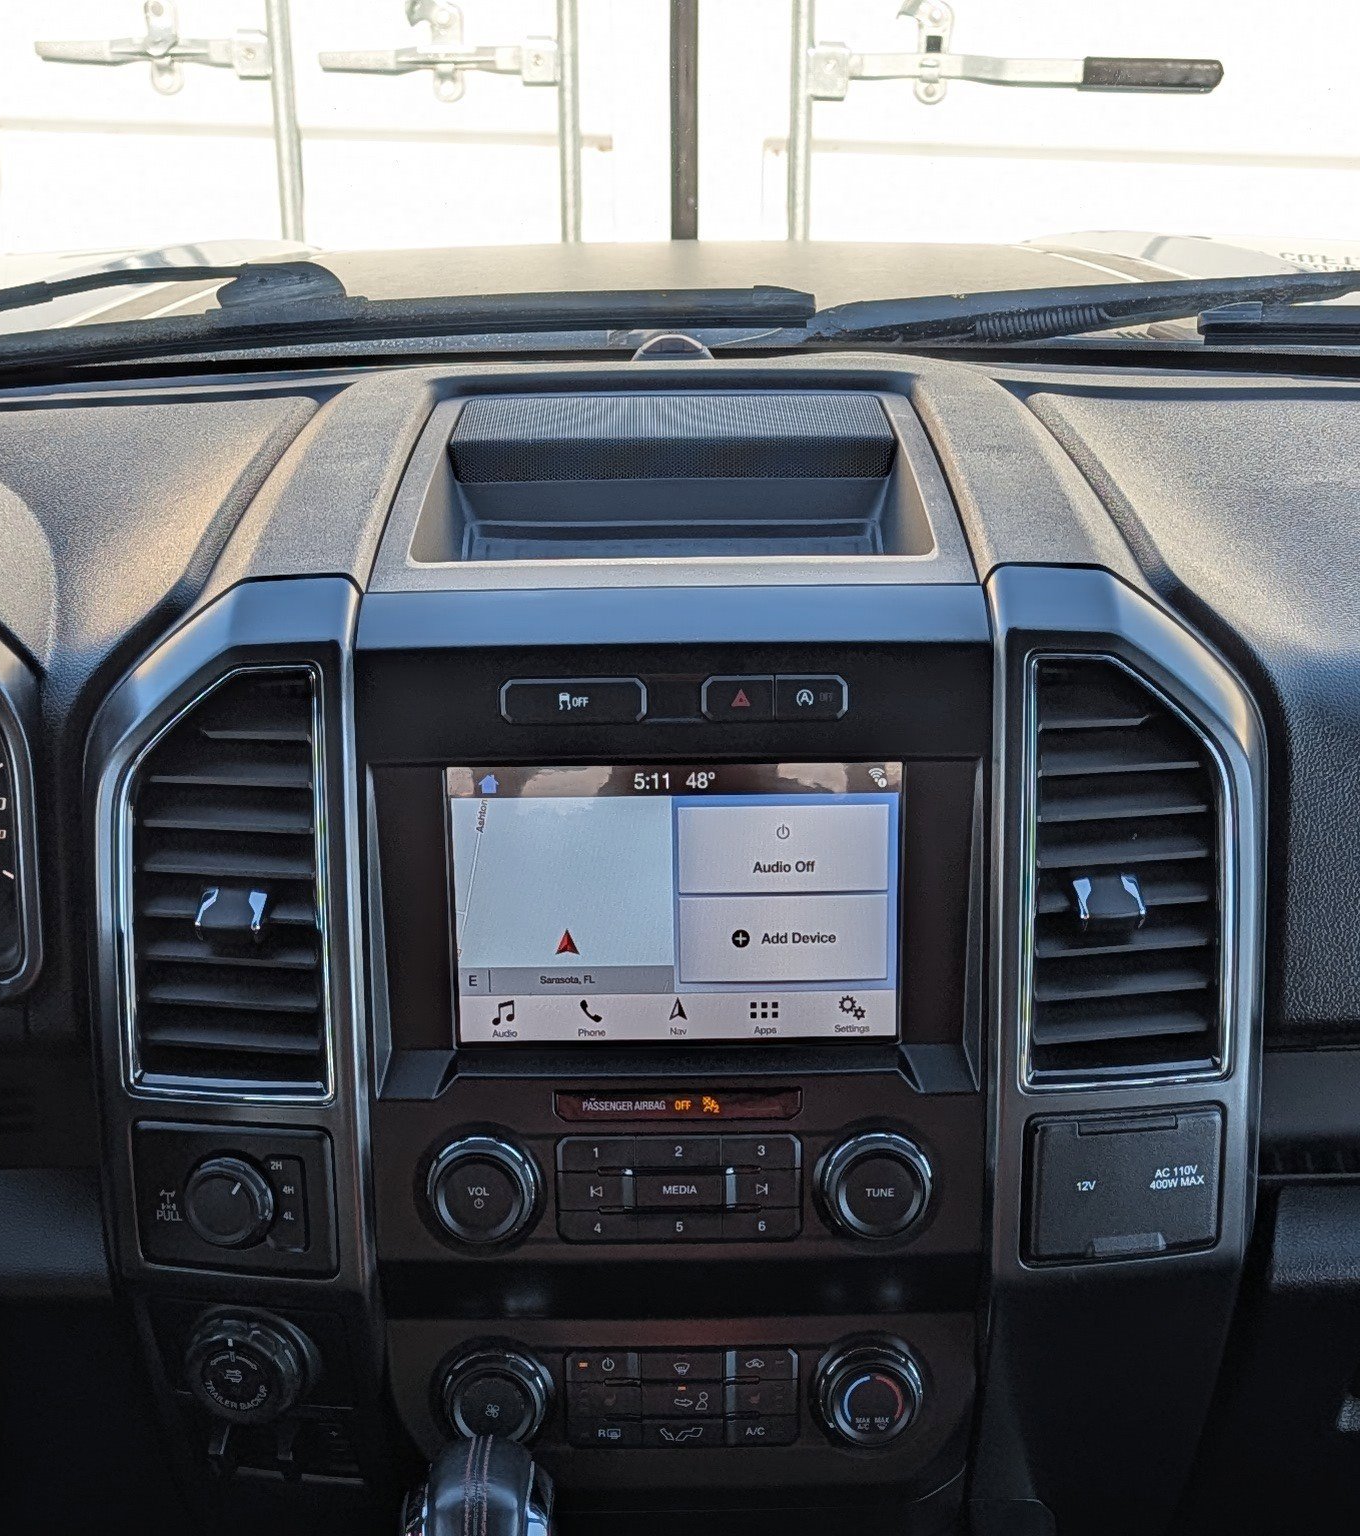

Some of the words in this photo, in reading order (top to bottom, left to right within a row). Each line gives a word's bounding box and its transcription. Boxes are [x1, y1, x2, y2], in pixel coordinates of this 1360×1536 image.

[572, 697, 590, 708] OFF
[633, 772, 671, 789] 5:11
[476, 799, 488, 834] Ashton
[753, 861, 792, 873] Audio
[795, 860, 816, 873] Off
[761, 933, 788, 945] Add
[792, 932, 837, 944] Device
[468, 975, 478, 987] E
[540, 975, 582, 986] Sarasota,
[584, 975, 595, 984] FL
[492, 1029, 518, 1038] Audio
[578, 1029, 606, 1038] Phone
[670, 1028, 687, 1036] Nav
[754, 1026, 777, 1036] Apps
[834, 1024, 870, 1034] Settings
[582, 1100, 633, 1111] PASSENGER
[634, 1100, 666, 1111] AIRBAG
[675, 1100, 691, 1111] OFF
[593, 1147, 599, 1158] 1
[675, 1146, 683, 1157] 2
[757, 1145, 765, 1156] 3
[270, 1161, 283, 1171] 2H
[1155, 1167, 1170, 1178] AC
[1173, 1165, 1198, 1176] 110V
[1076, 1181, 1096, 1191] 12V
[1150, 1178, 1180, 1190] 400W
[1180, 1175, 1205, 1187] MAX
[283, 1185, 295, 1194] 4H
[468, 1186, 490, 1197] VOL
[663, 1185, 697, 1194] MEDIA
[866, 1187, 895, 1198] TUNE
[156, 1210, 183, 1221] PULL
[594, 1222, 602, 1233] 4
[676, 1221, 684, 1232] 5
[758, 1220, 766, 1231] 6
[204, 1380, 239, 1409] TRAILER
[240, 1385, 268, 1410] BACKUP
[598, 1429, 606, 1438] R
[745, 1427, 765, 1436] A/C
